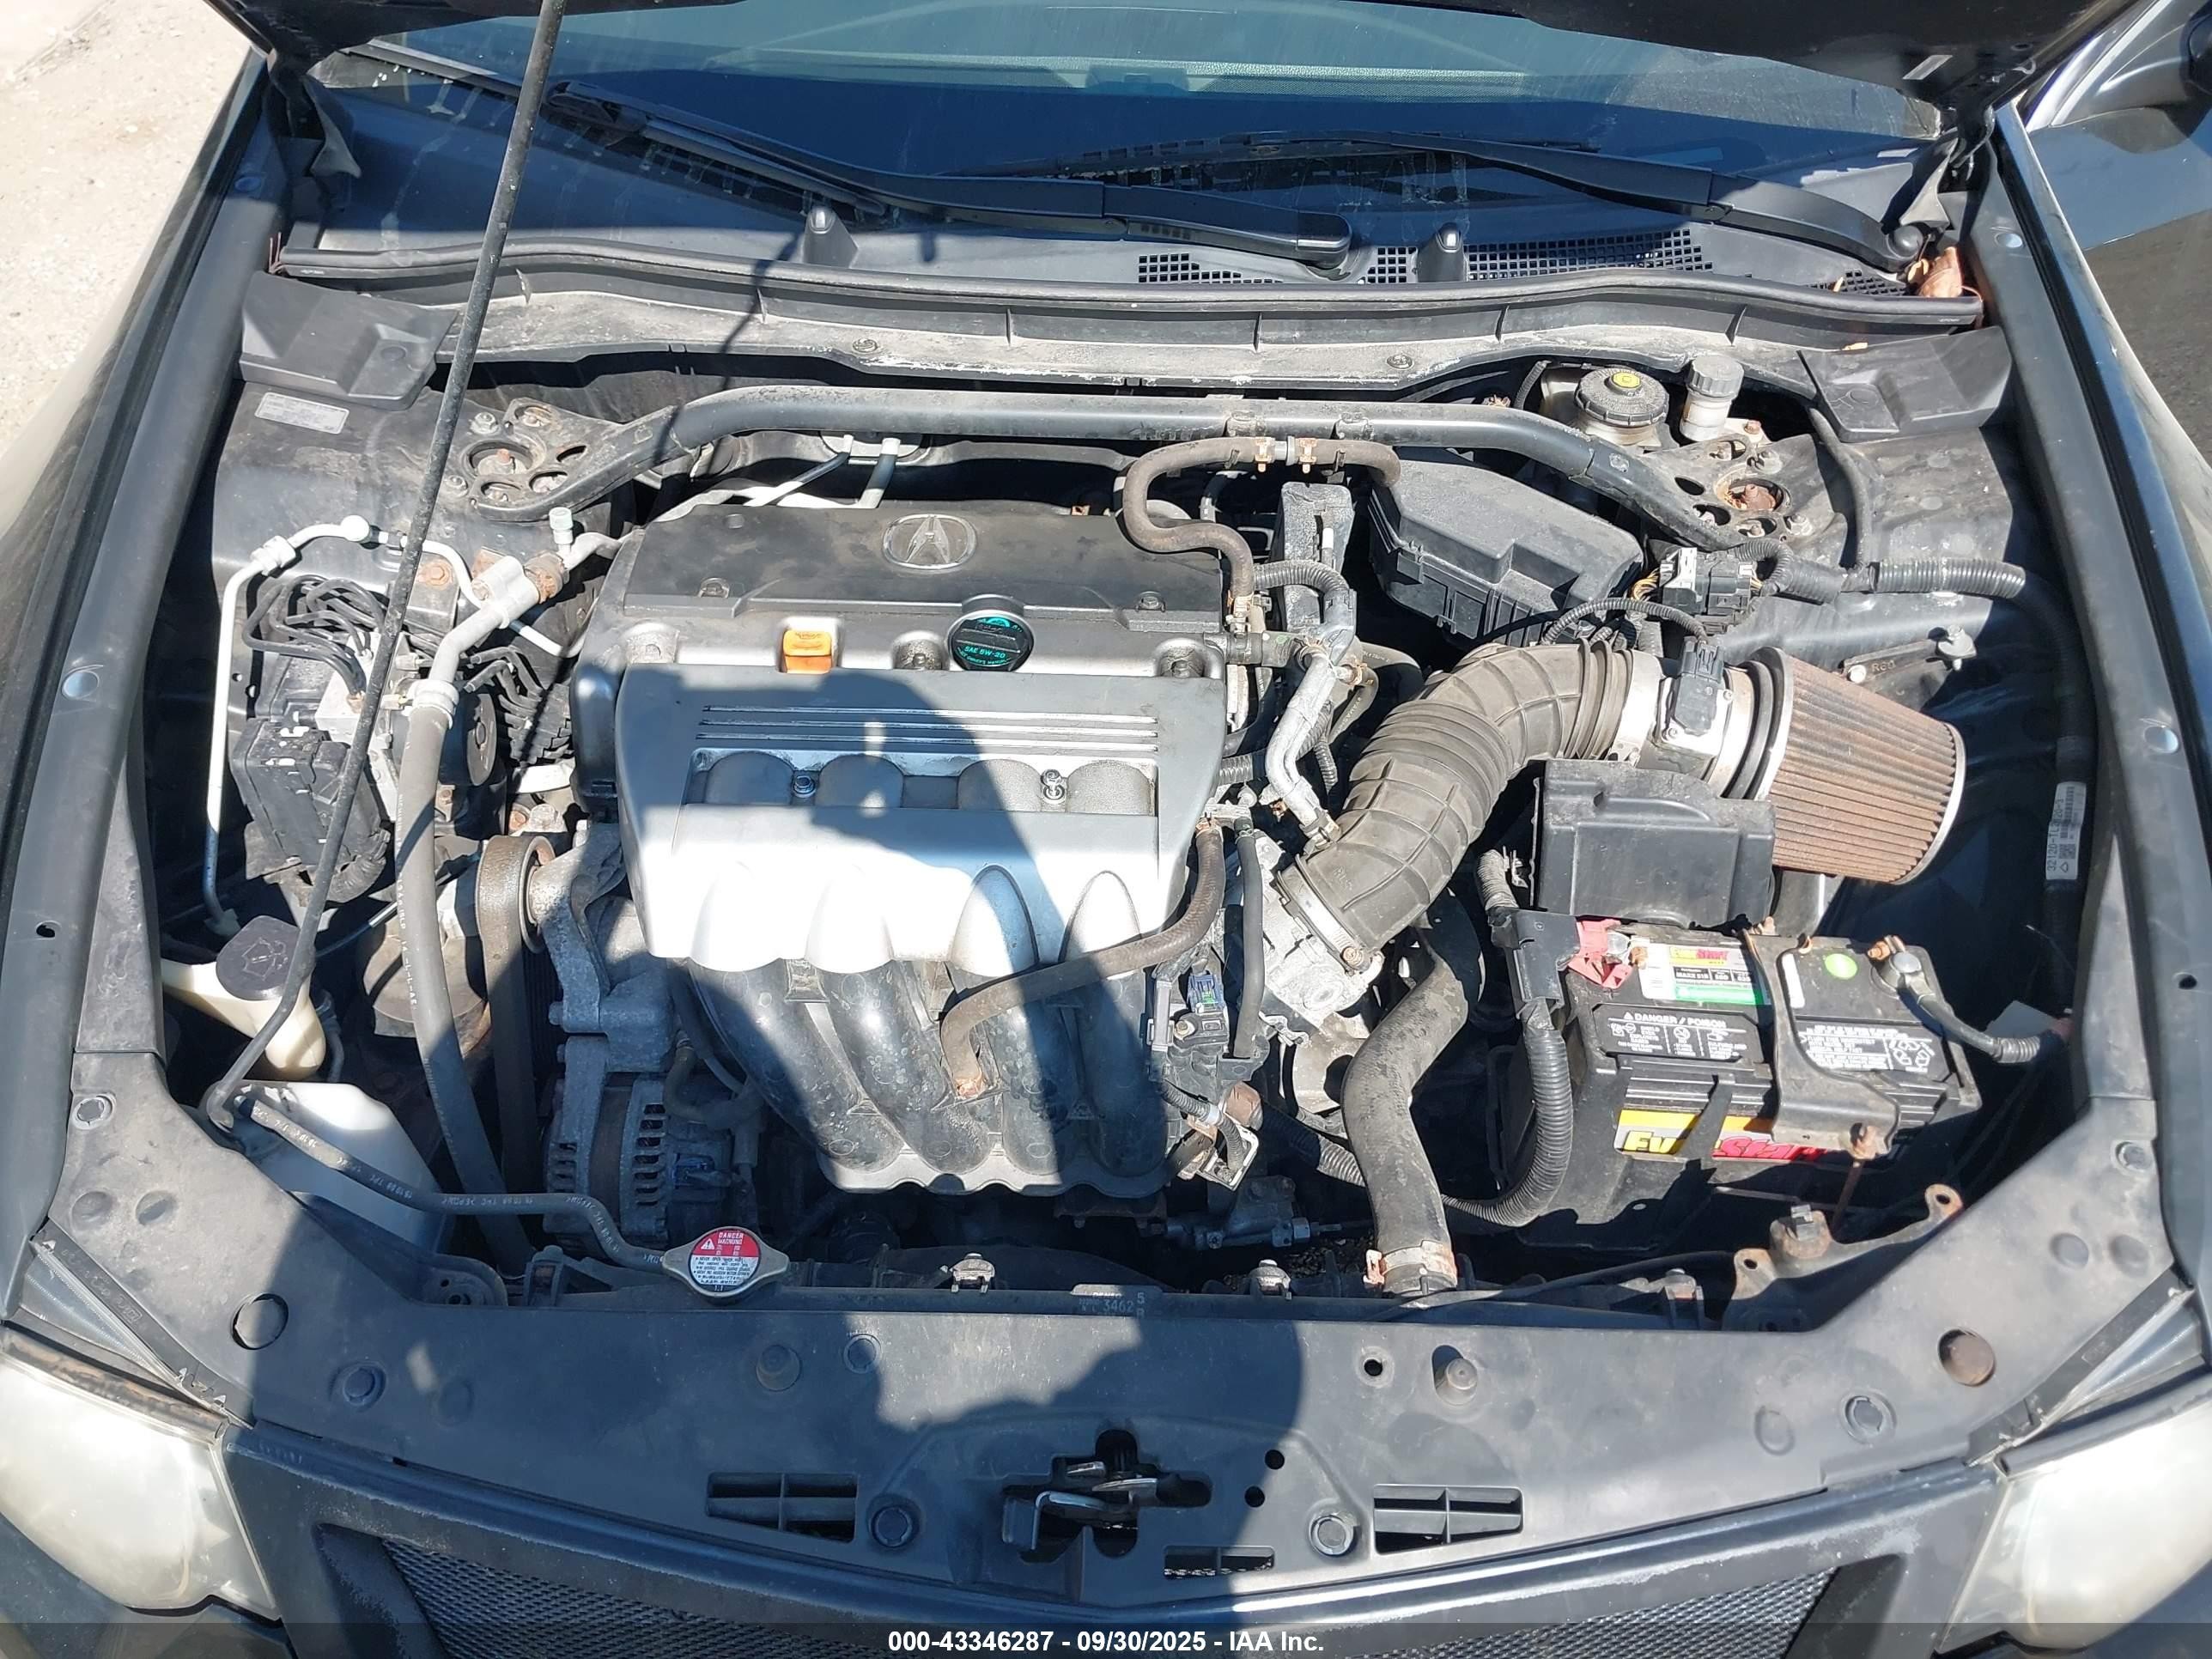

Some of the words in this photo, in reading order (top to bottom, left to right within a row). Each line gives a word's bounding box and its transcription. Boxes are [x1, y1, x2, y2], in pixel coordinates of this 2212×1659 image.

[963, 646, 979, 654] SAE
[979, 647, 1006, 659] 5W-20
[1634, 1012, 1677, 1024] DANGER
[1687, 1018, 1727, 1029] POISON
[1103, 1299, 1134, 1313] 3462
